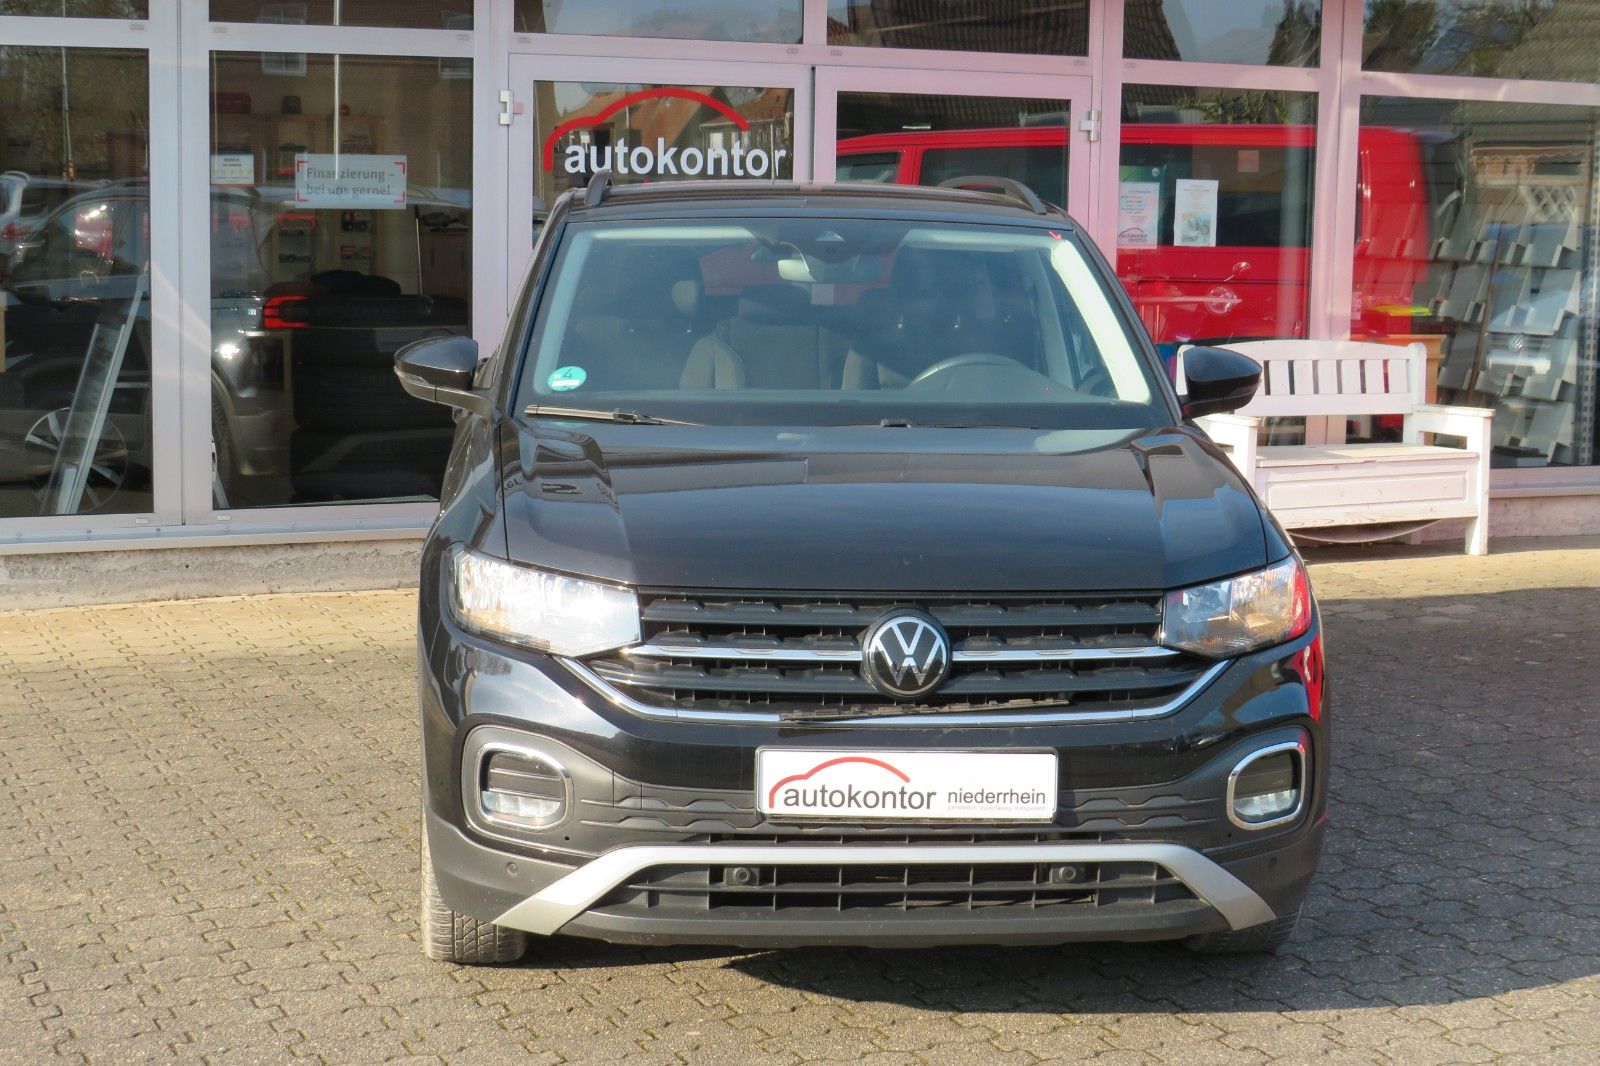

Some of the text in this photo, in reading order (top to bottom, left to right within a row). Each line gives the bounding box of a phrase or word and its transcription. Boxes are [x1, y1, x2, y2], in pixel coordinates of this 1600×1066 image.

[564, 137, 787, 176] autokontor
[783, 784, 1046, 810] autokontor niederrhein
